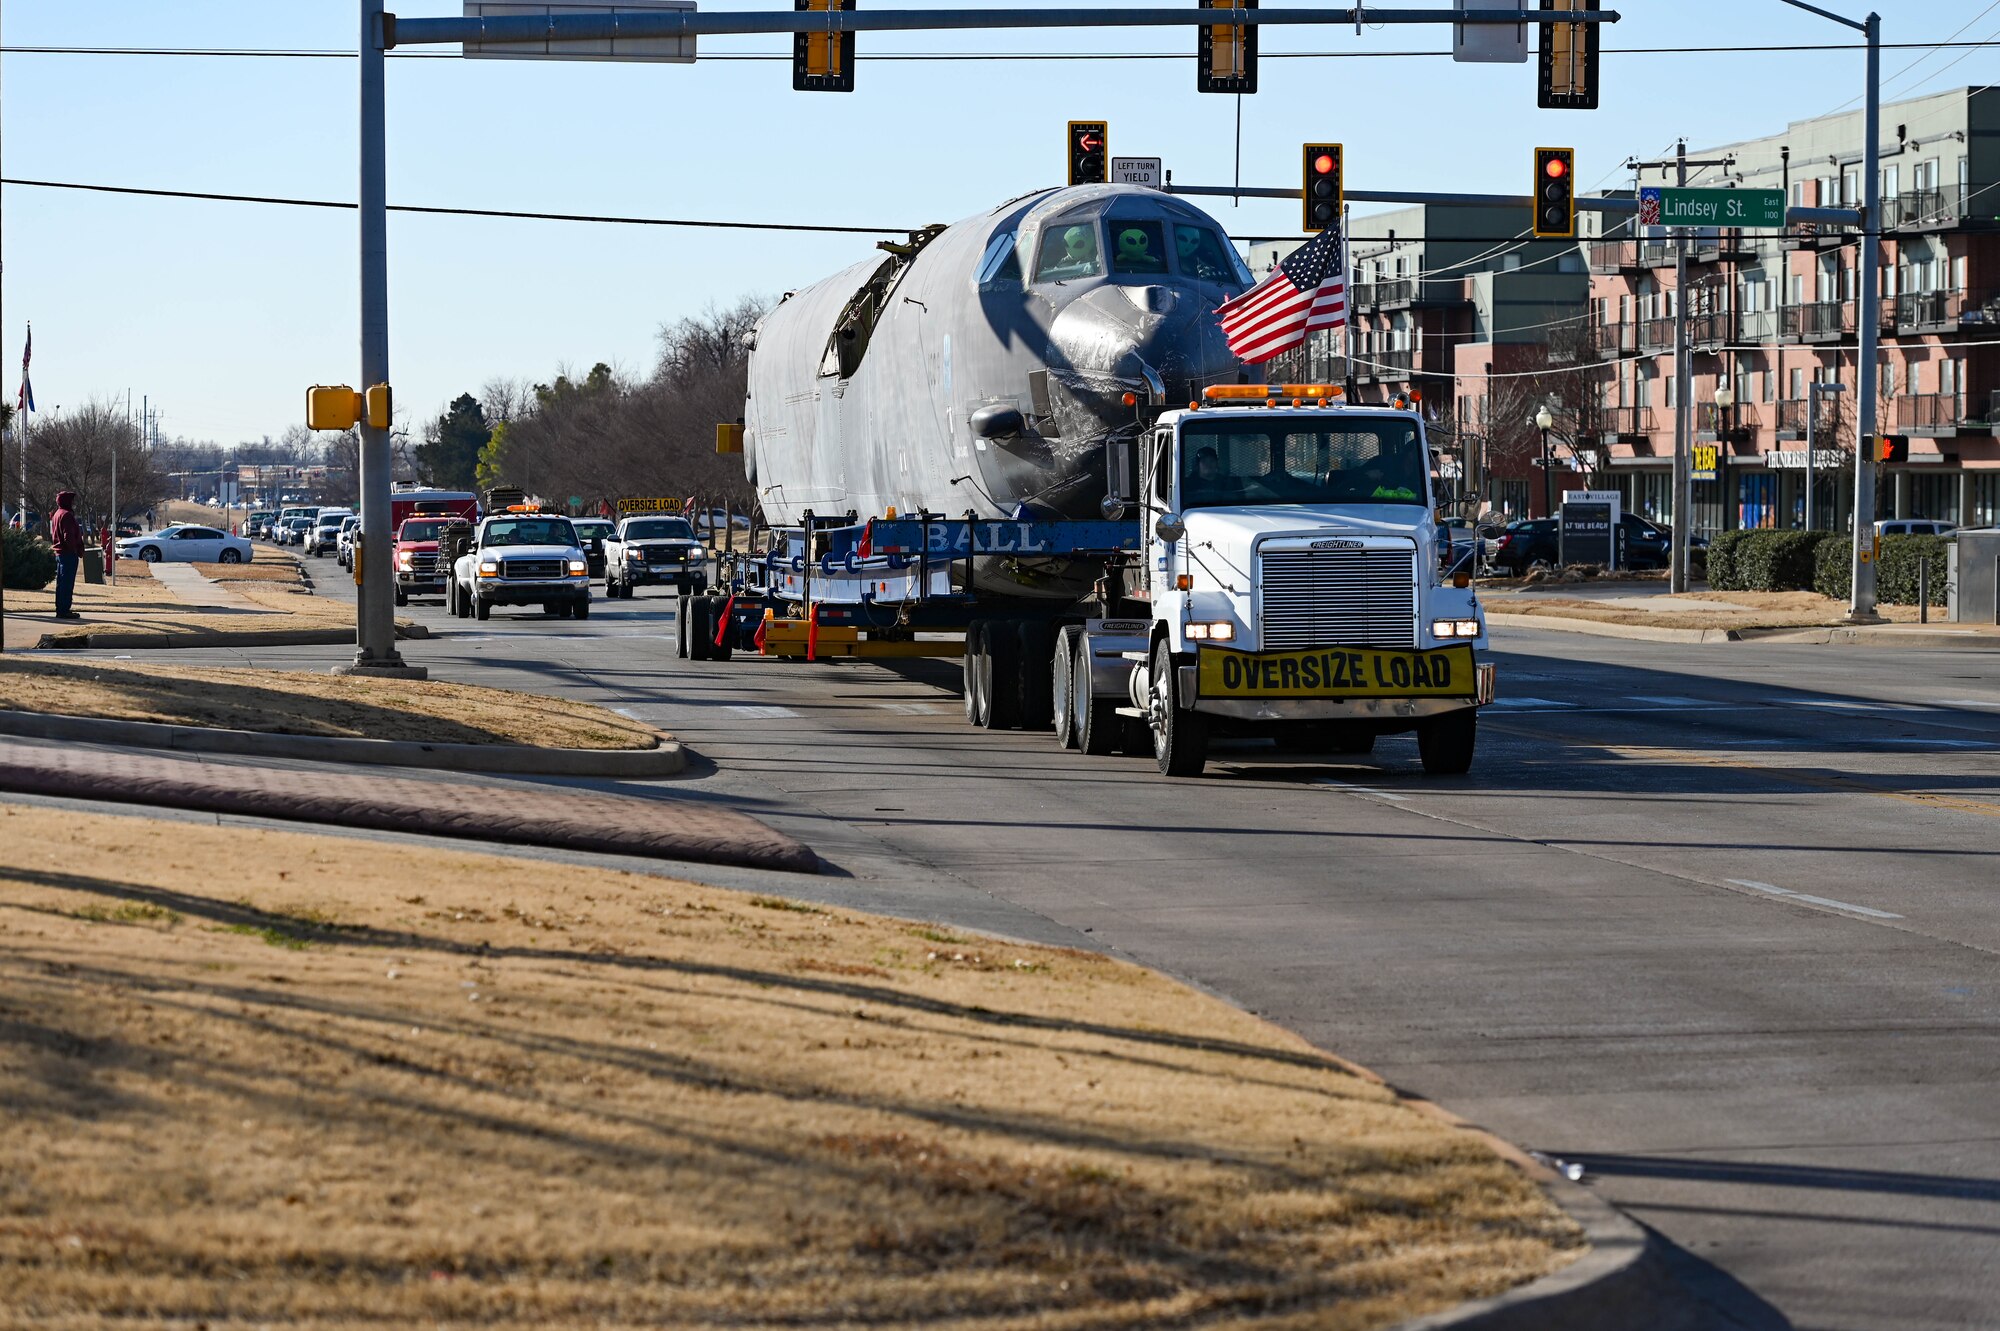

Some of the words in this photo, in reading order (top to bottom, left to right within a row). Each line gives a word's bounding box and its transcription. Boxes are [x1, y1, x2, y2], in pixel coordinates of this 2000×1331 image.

[1118, 162, 1134, 170] LEFT
[1136, 162, 1155, 170] TURN
[1123, 173, 1150, 182] YIELD
[1763, 198, 1779, 206] East
[1664, 198, 1718, 220] Lindsey
[1726, 199, 1747, 217] St.
[1764, 211, 1779, 219] 1100
[619, 499, 658, 511] OVERSIZE
[659, 499, 680, 510] LOAD
[918, 523, 1046, 552] BALL
[1311, 540, 1364, 549] FREIGHTLINER
[1103, 622, 1144, 630] FREIGHTLINER
[1222, 650, 1368, 690] OVERSIZE
[1374, 654, 1451, 688] LOAD
